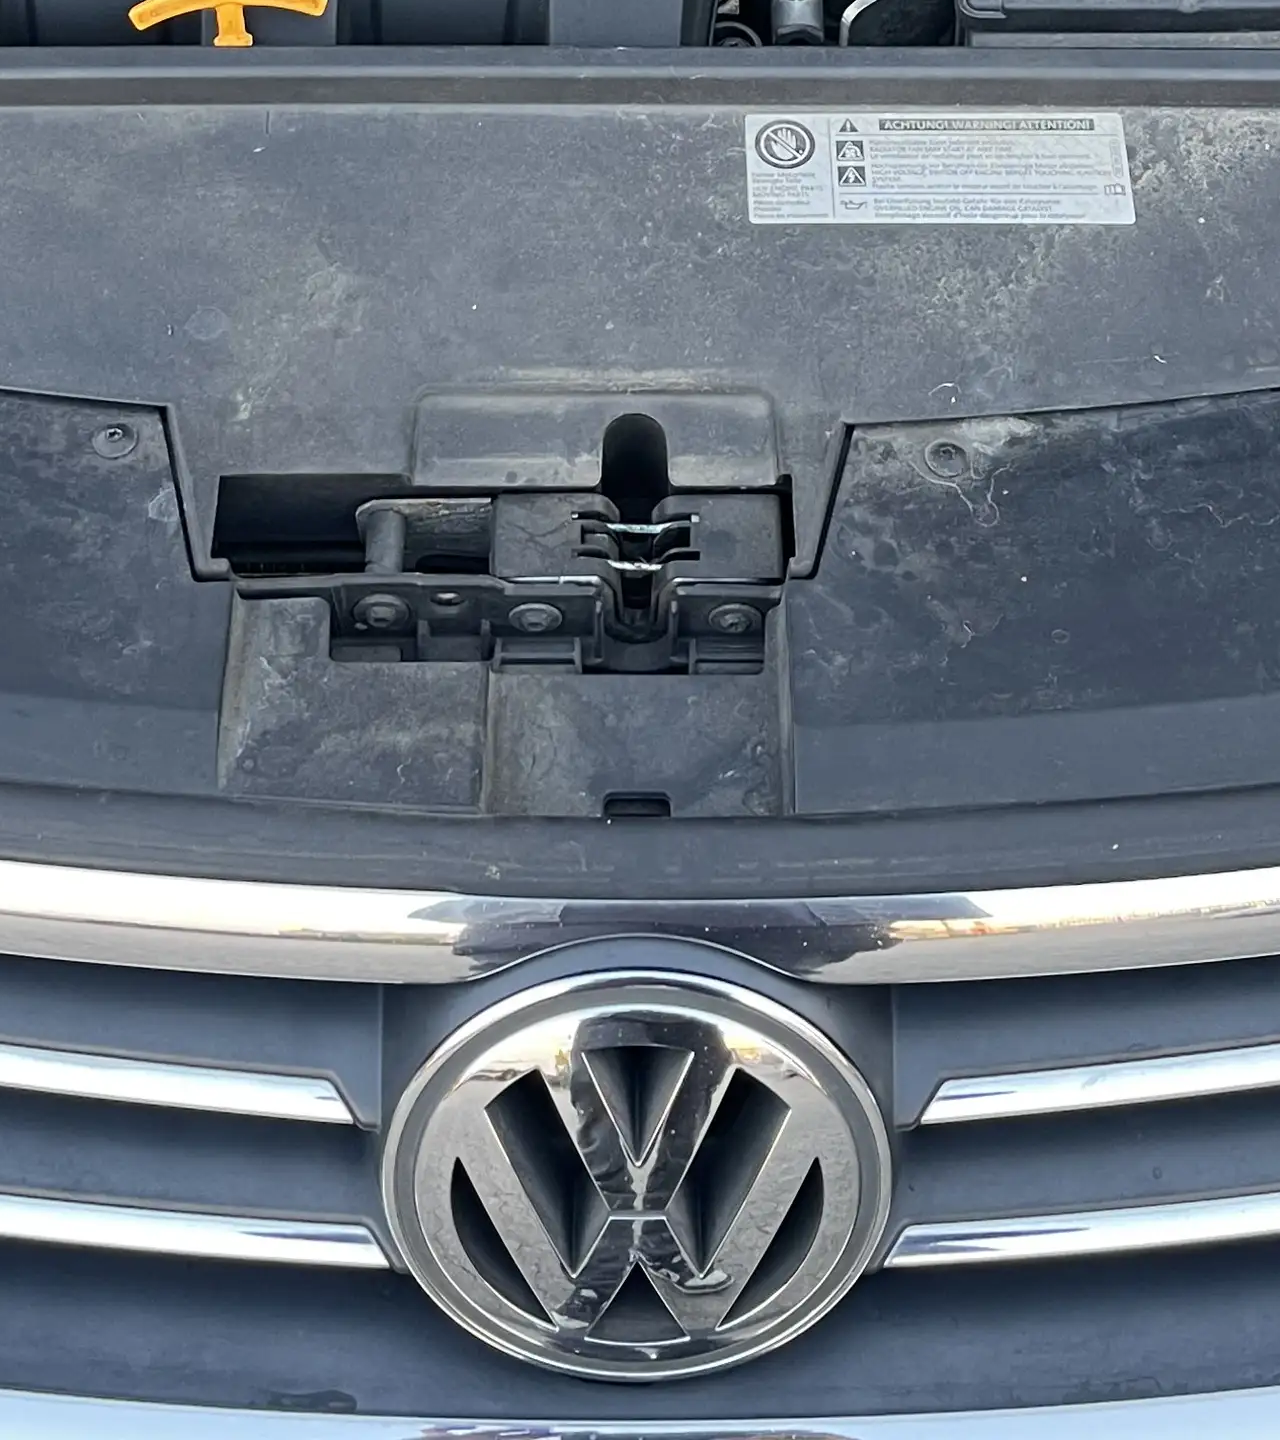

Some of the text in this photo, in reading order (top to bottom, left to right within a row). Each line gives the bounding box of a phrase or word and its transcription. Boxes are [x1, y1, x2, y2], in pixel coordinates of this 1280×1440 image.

[884, 119, 1091, 131] ACHTUNG! WARNING! ATTENTION!
[384, 970, 891, 1381] VW
